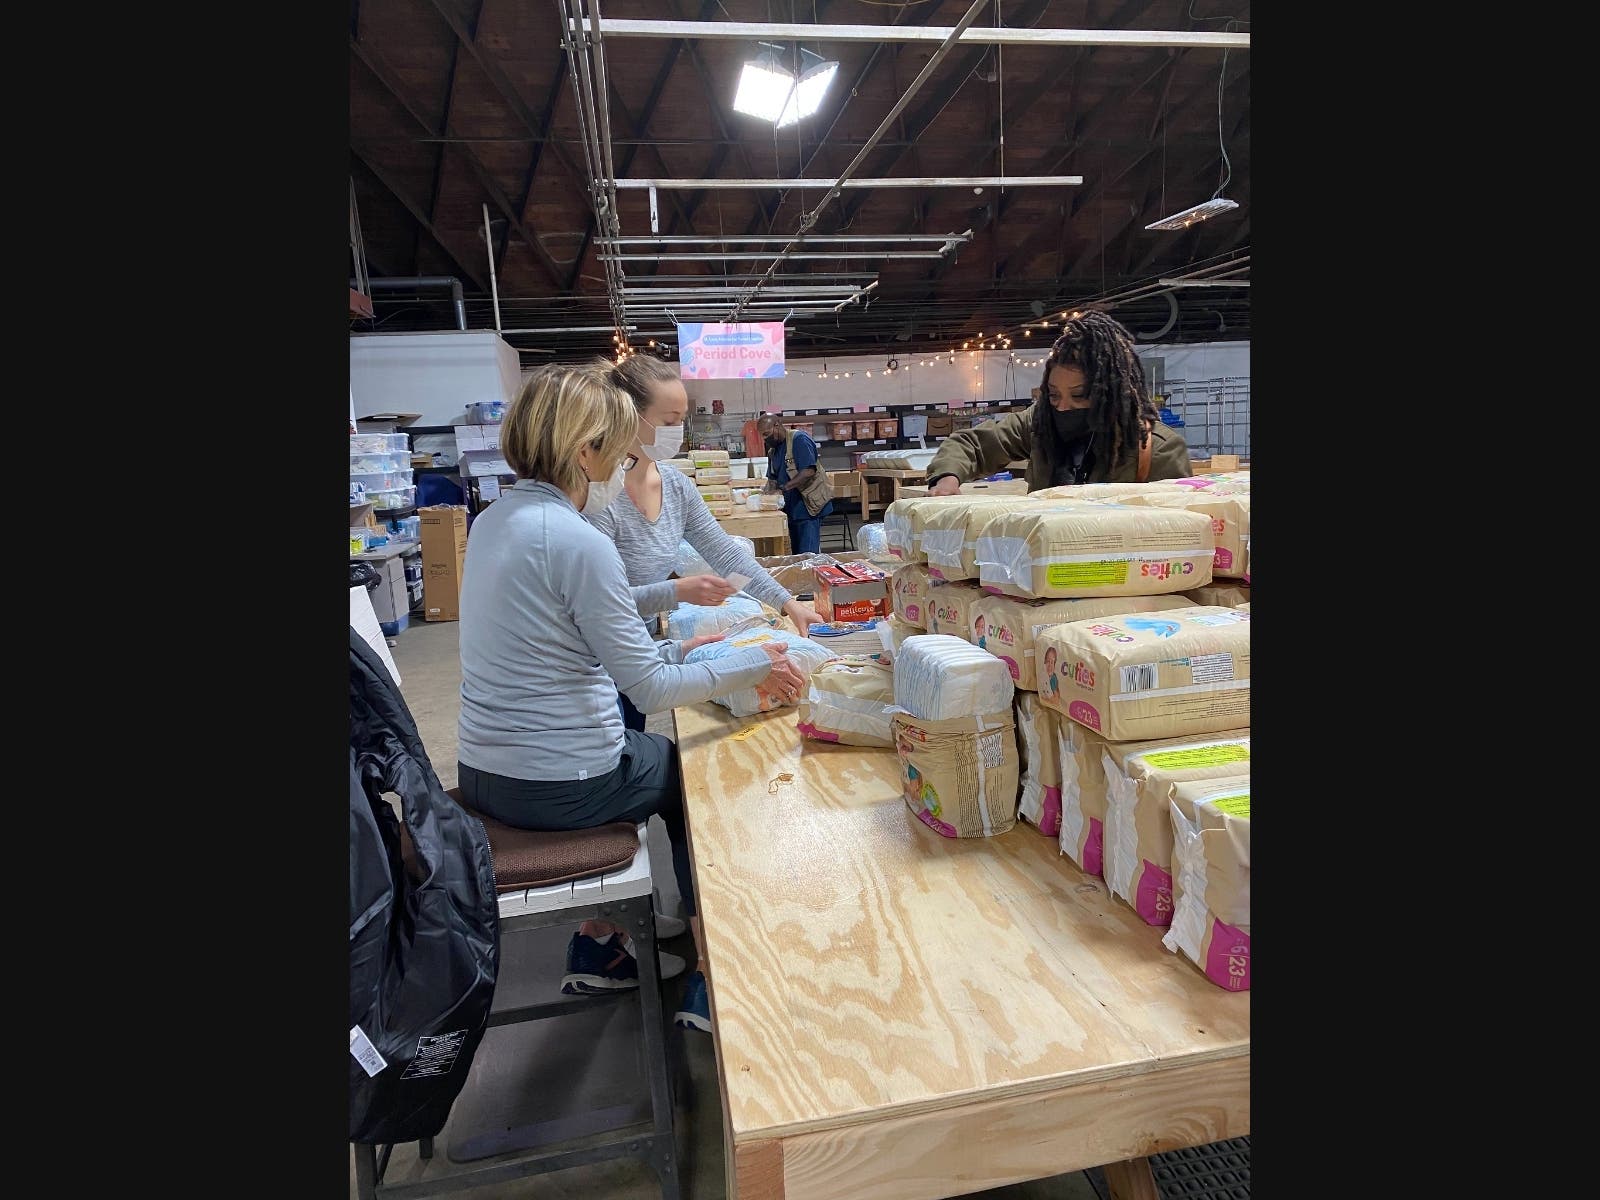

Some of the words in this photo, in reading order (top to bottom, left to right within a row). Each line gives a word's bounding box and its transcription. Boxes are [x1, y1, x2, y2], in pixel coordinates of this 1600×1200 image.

[694, 346, 736, 359] Period
[740, 346, 771, 359] Cove
[1141, 561, 1194, 581] cuties
[1060, 660, 1095, 688] cuties
[1082, 708, 1093, 726] 23
[1155, 893, 1172, 912] 23
[1230, 945, 1249, 955] 6
[1228, 956, 1247, 977] 23
